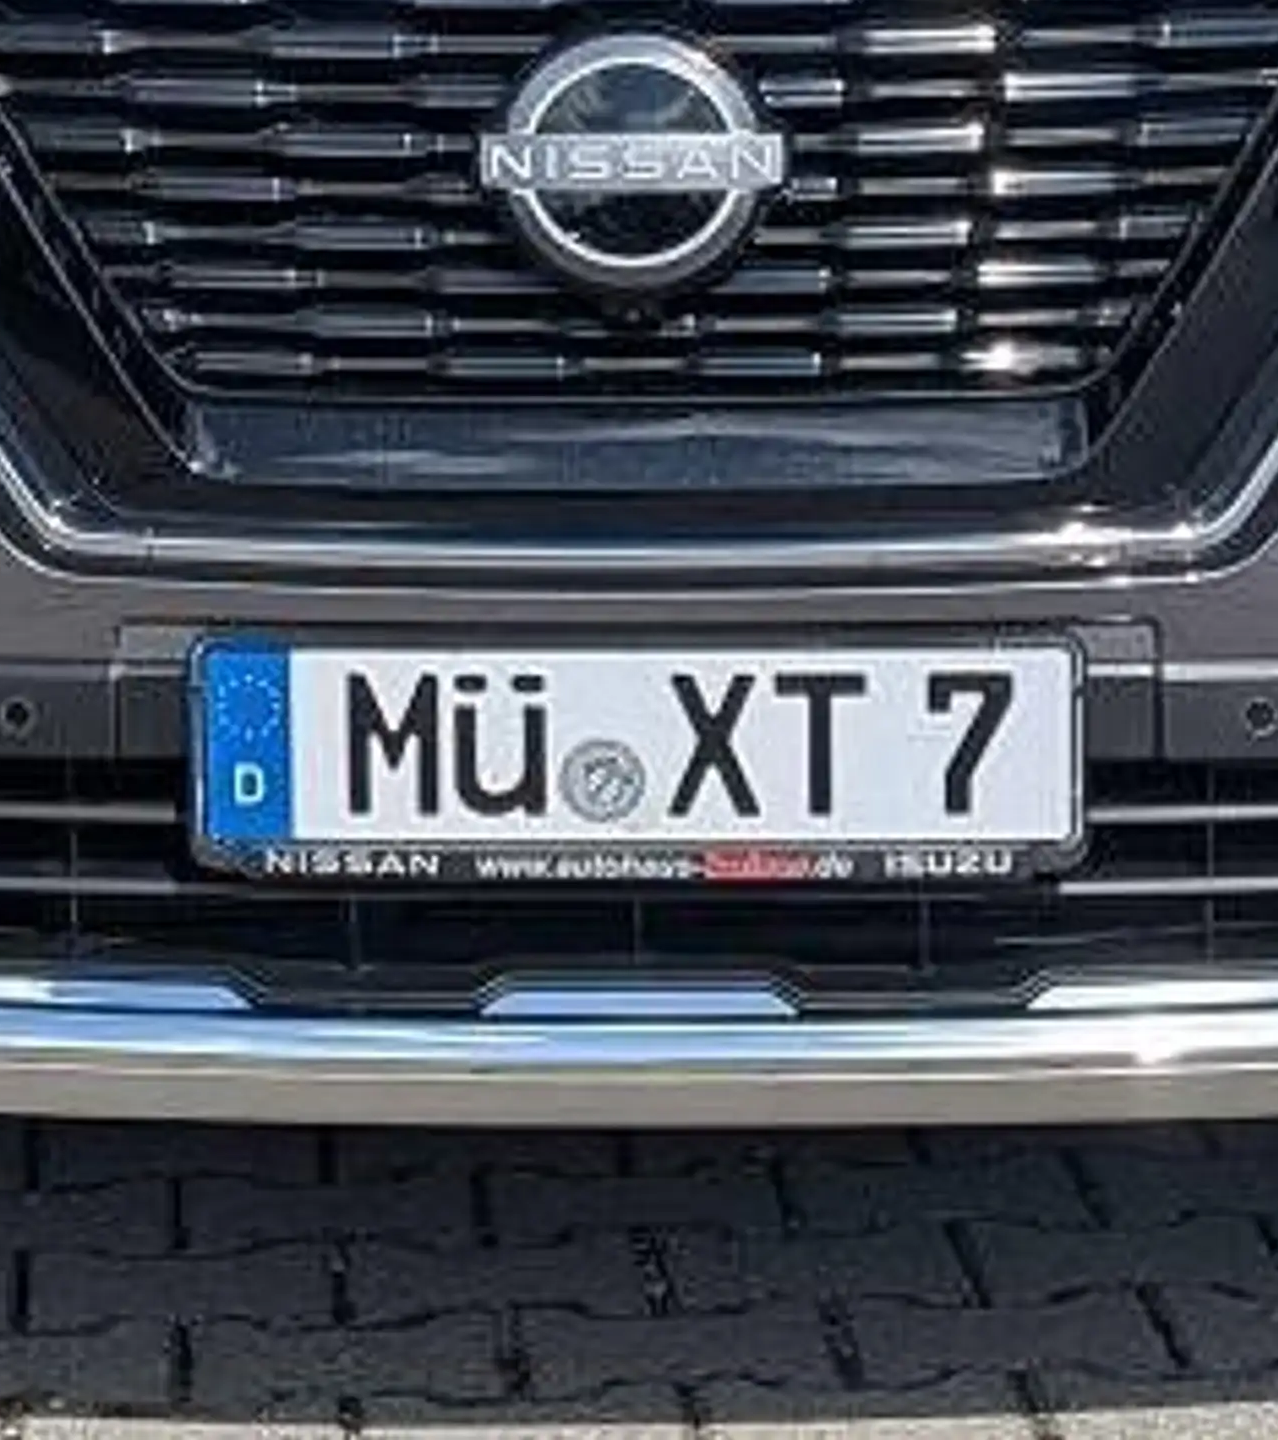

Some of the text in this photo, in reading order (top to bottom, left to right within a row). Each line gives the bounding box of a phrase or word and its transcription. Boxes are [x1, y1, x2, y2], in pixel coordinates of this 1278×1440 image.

[489, 143, 773, 180] NISSAN
[668, 672, 867, 818] XT
[927, 672, 1014, 815] 7
[233, 762, 266, 806] D
[264, 847, 441, 879] NISSAN
